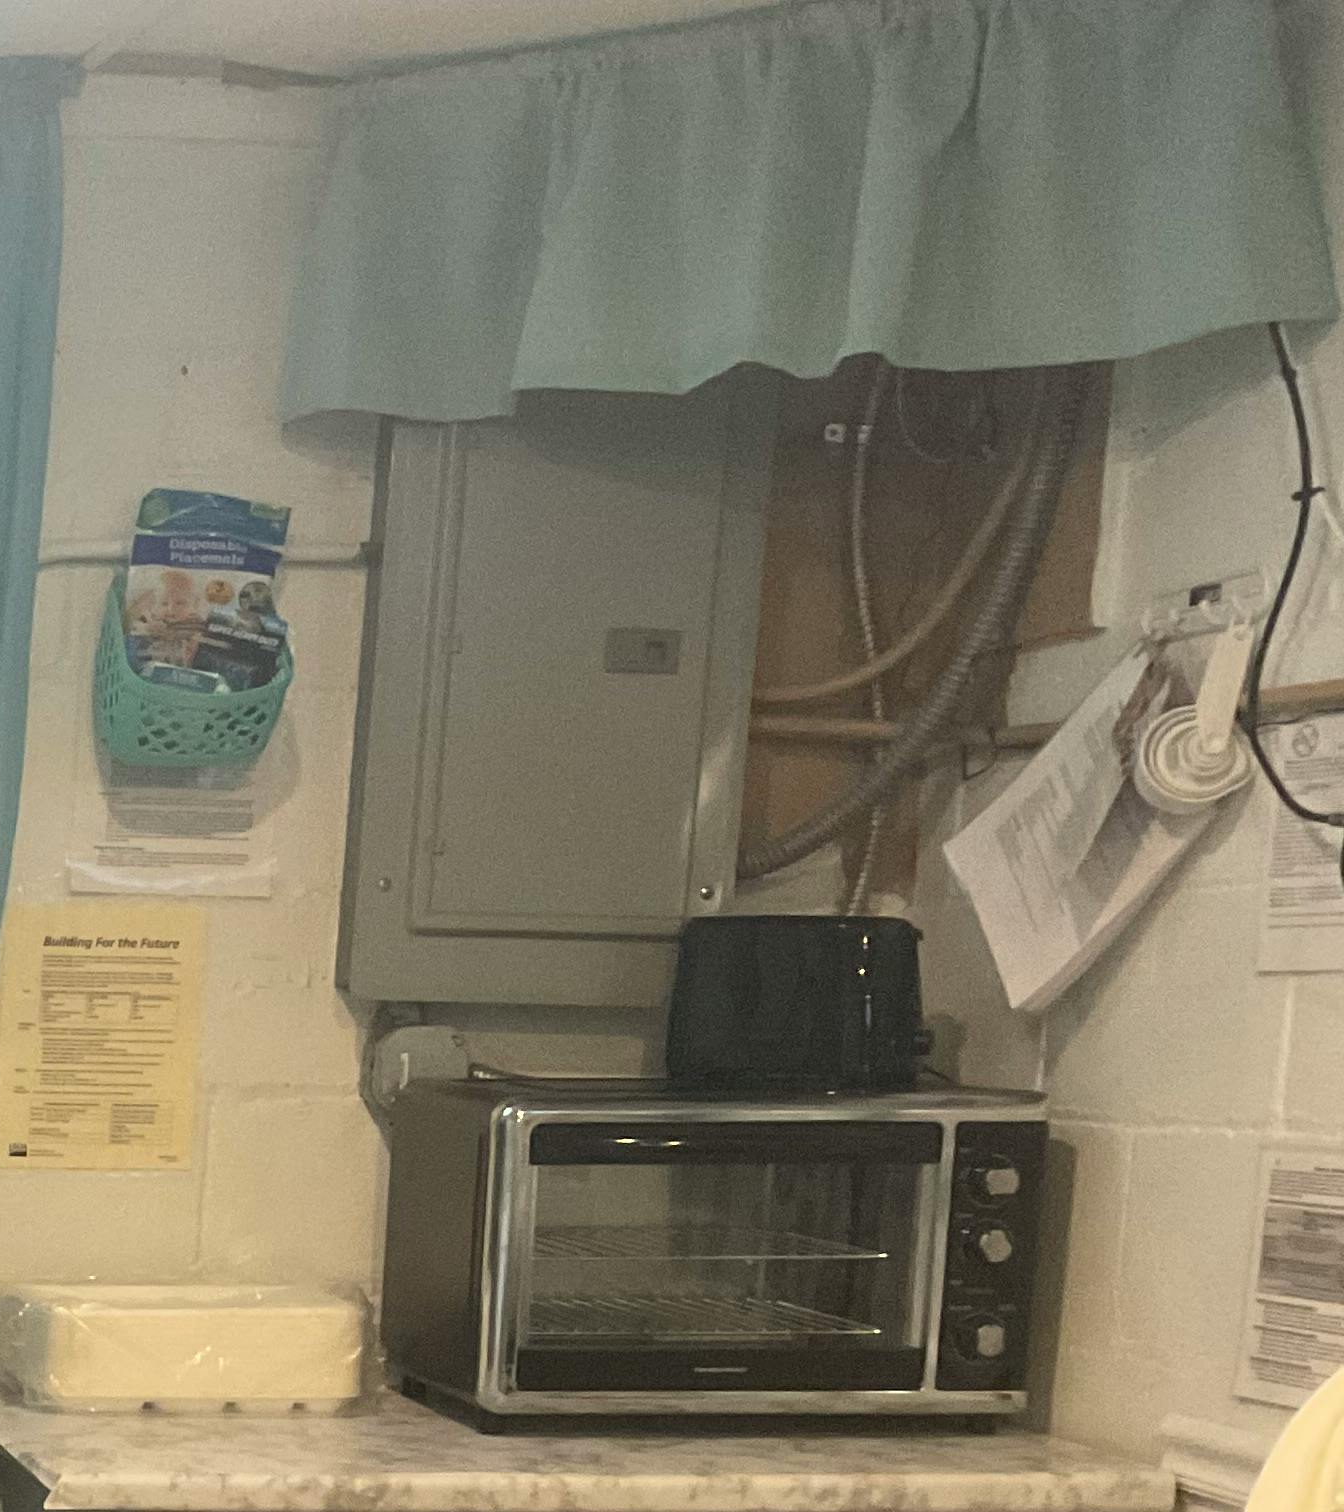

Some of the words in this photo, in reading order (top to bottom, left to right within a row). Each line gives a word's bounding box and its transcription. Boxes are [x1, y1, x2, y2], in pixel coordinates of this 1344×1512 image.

[43, 936, 93, 949] Building
[96, 936, 115, 948] For
[117, 937, 137, 949] the
[140, 938, 180, 949] Future
